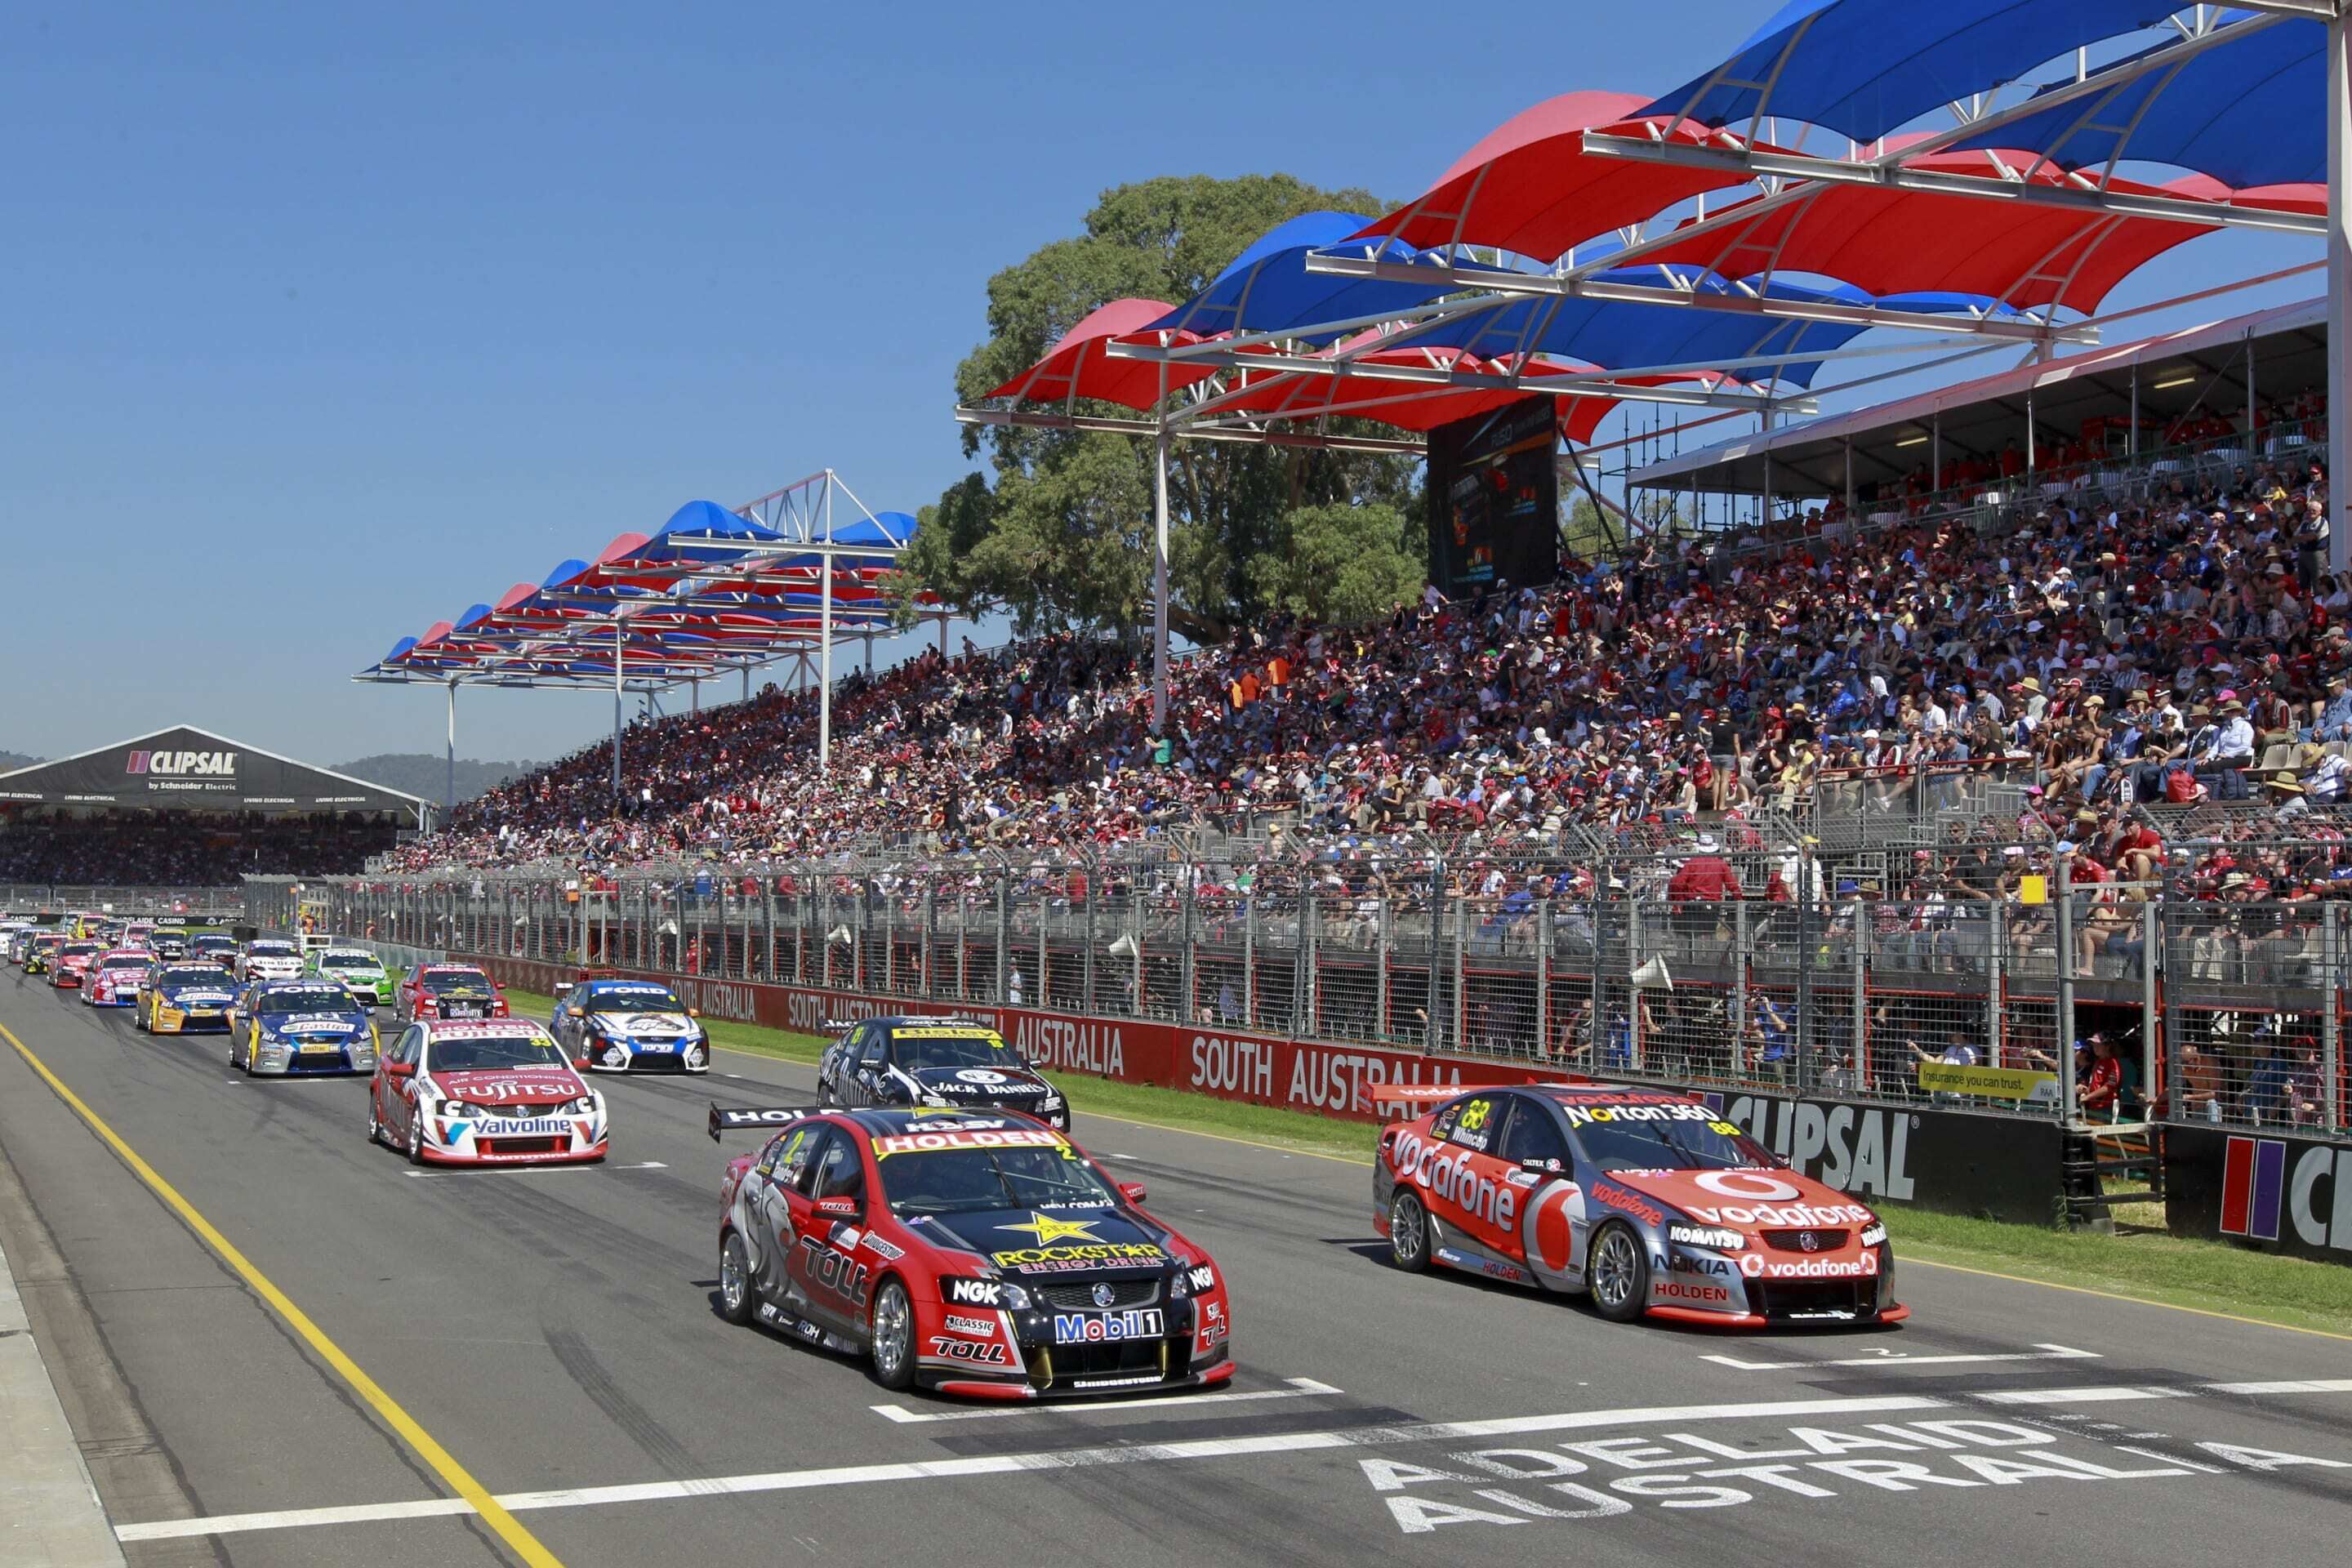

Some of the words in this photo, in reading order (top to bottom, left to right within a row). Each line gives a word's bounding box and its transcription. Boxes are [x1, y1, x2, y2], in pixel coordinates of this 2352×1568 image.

[149, 751, 235, 774] CLIPSAL
[149, 782, 158, 791] by
[160, 782, 203, 790] Schneider
[158, 916, 186, 924] CASINO
[268, 986, 341, 994] FORD
[598, 987, 667, 995] FORD
[702, 982, 756, 1021] AUSTRALIA
[788, 992, 826, 1030] SOUTH
[434, 1031, 540, 1039] FUJITSU
[530, 1038, 552, 1047] 33
[1016, 1016, 1125, 1076] AUSTRALIA
[1192, 1036, 1273, 1098] SOUTH
[448, 1077, 469, 1085] AIR
[472, 1074, 572, 1083] CONDITIONING
[930, 1082, 978, 1094] JACK
[1922, 1070, 1964, 1085] Insurance
[1965, 1076, 1983, 1088] you
[1983, 1079, 1999, 1089] can
[2000, 1077, 2025, 1090] trust.
[452, 1080, 576, 1101] FUJITSU
[2040, 1086, 2054, 1097] RAA
[471, 1119, 571, 1135] Valvoline
[1708, 1121, 1741, 1136] 88
[785, 1130, 804, 1164] 2
[885, 1131, 1058, 1152] HOLDEN
[1452, 1125, 1488, 1152] Whincup
[1728, 1095, 1914, 1200] CLIPSAL
[1056, 1145, 1078, 1160] 2
[1522, 1158, 1544, 1168] CALTEX
[1393, 1129, 1515, 1232] vodafone
[1592, 1181, 1663, 1228] vodafone
[1683, 1202, 1872, 1227] vodafone
[1670, 1226, 1745, 1249] KOMATSU
[800, 1234, 869, 1307] TOLL
[1022, 1258, 1096, 1273] ENERGY
[1105, 1256, 1160, 1267] DRINK
[1483, 1261, 1521, 1281] HOLDEN
[1767, 1258, 1861, 1276] vodafone
[953, 1280, 1001, 1305] NGK
[1655, 1283, 1727, 1301] HOLDEN
[797, 1319, 821, 1339] ROH
[954, 1317, 994, 1331] CLASSIC
[1055, 1313, 1140, 1343] Mobil
[930, 1336, 1006, 1364] TOLL
[1357, 1414, 2172, 1491] ADELAIDE
